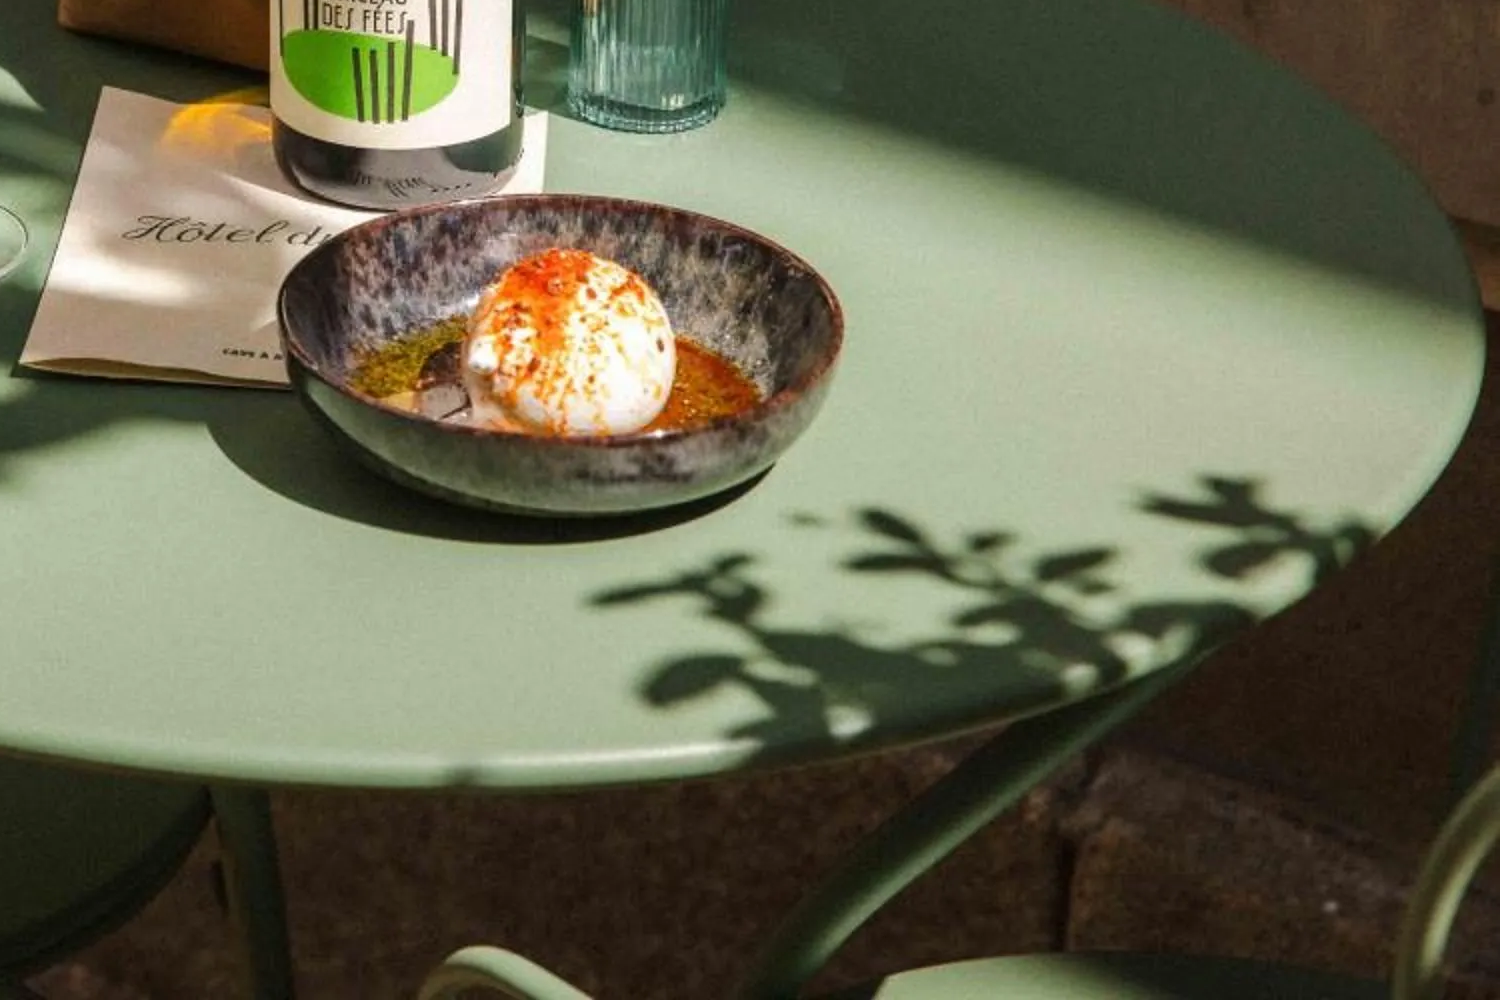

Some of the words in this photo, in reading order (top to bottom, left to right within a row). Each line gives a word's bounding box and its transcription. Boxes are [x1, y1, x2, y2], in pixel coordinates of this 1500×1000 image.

[322, 3, 355, 30] DES
[363, 0, 409, 35] FÉES
[122, 214, 284, 245] Hôtel
